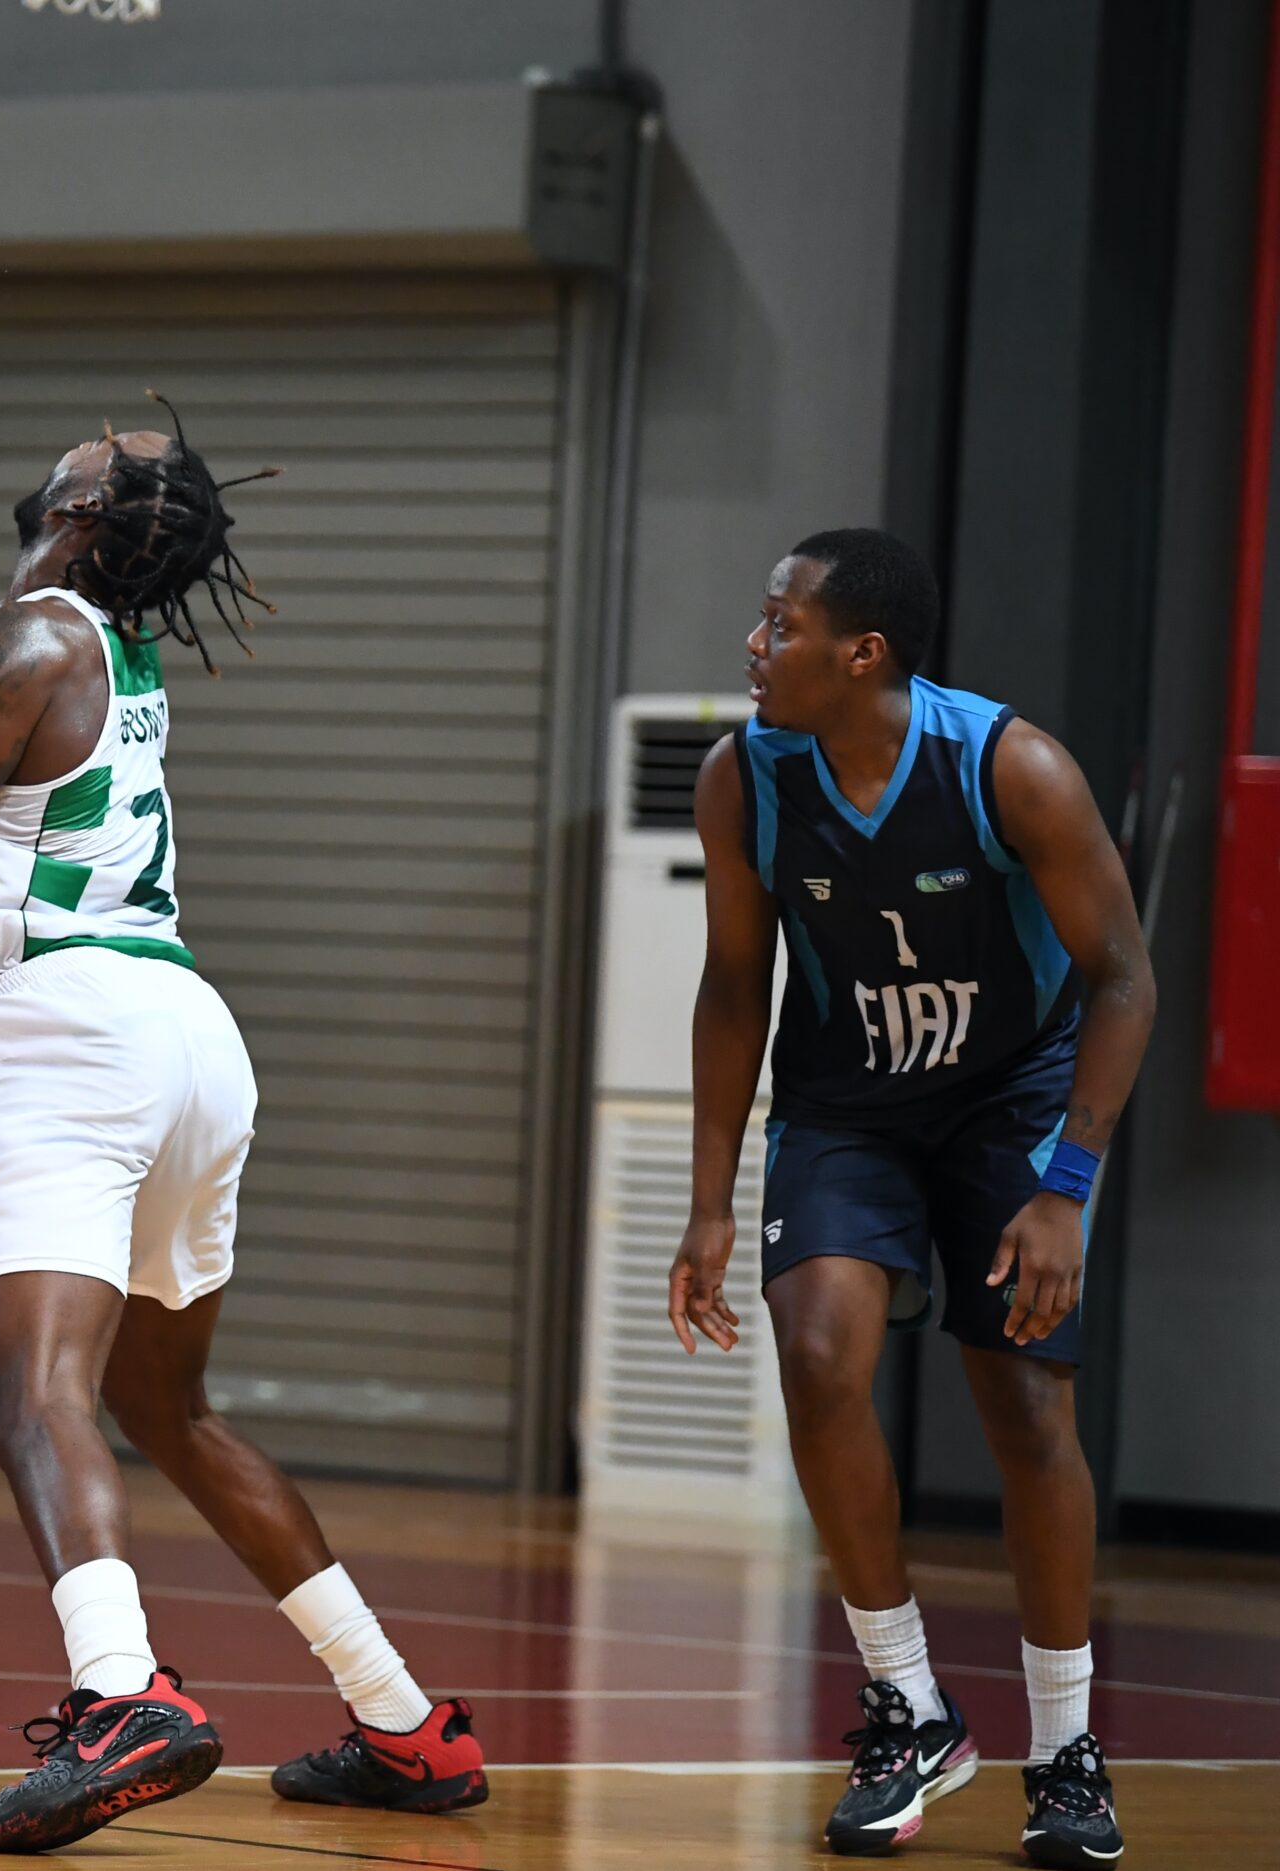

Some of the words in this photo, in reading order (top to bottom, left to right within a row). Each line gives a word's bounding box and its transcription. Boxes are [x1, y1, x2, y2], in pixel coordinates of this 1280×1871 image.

[122, 787, 176, 917] 2
[880, 910, 918, 969] 1
[854, 979, 979, 1074] FIAT
